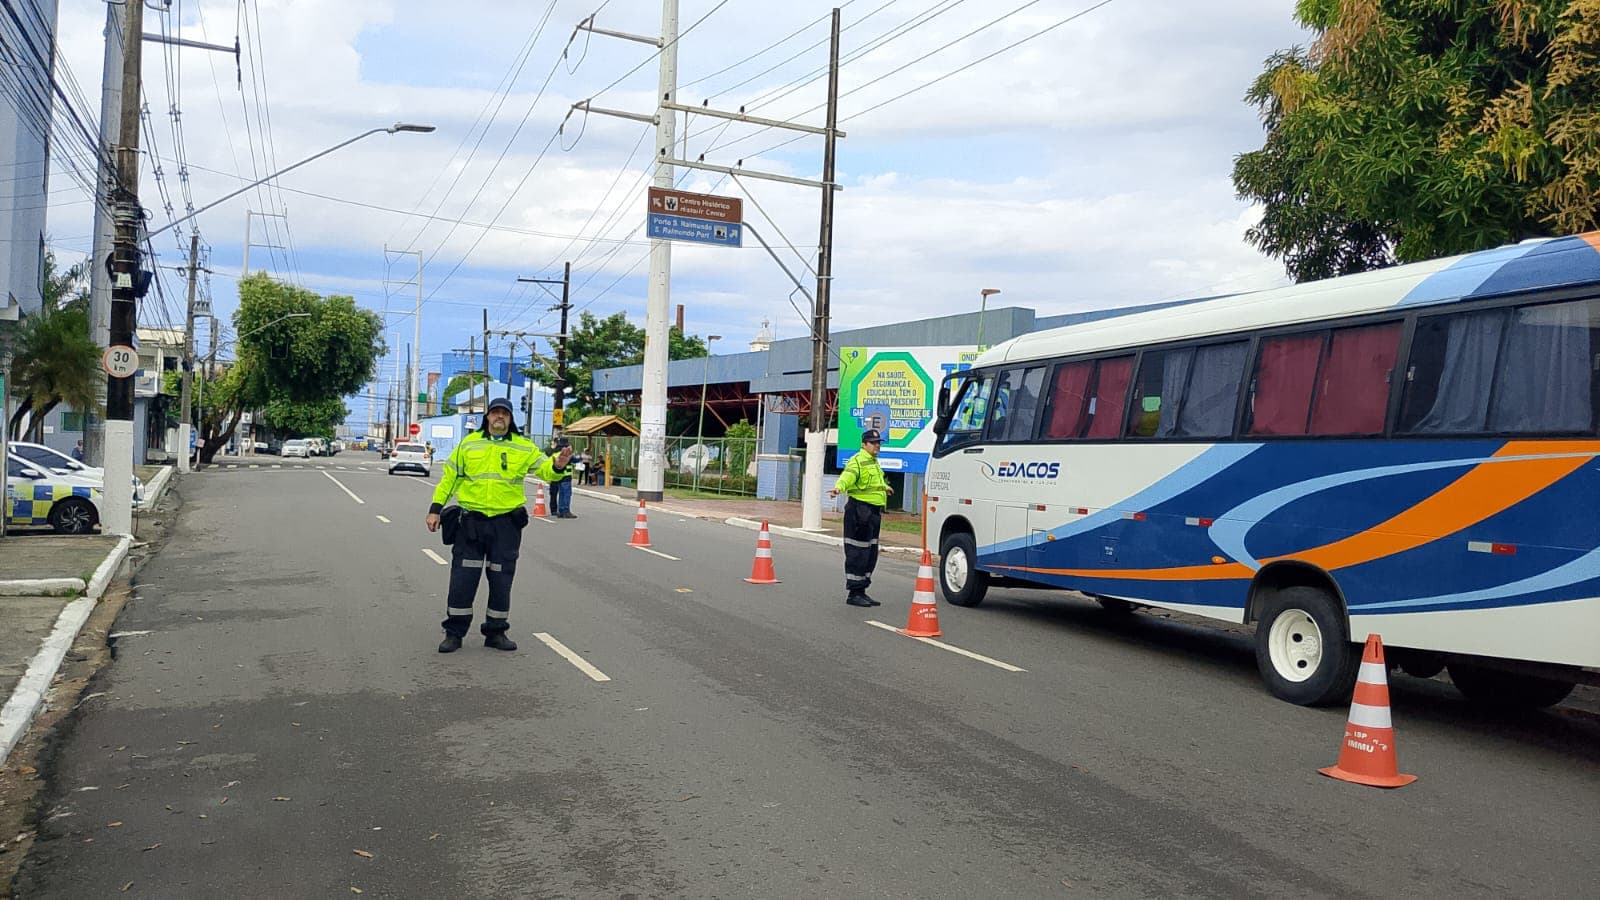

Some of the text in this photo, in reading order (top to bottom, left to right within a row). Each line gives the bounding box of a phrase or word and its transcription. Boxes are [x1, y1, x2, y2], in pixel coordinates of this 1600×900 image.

[679, 197, 701, 206] Centro
[653, 217, 671, 226] Porto
[113, 351, 129, 363] 30
[890, 398, 921, 406] PRESENTE
[922, 409, 932, 418] DE
[998, 461, 1060, 479] EDACOS
